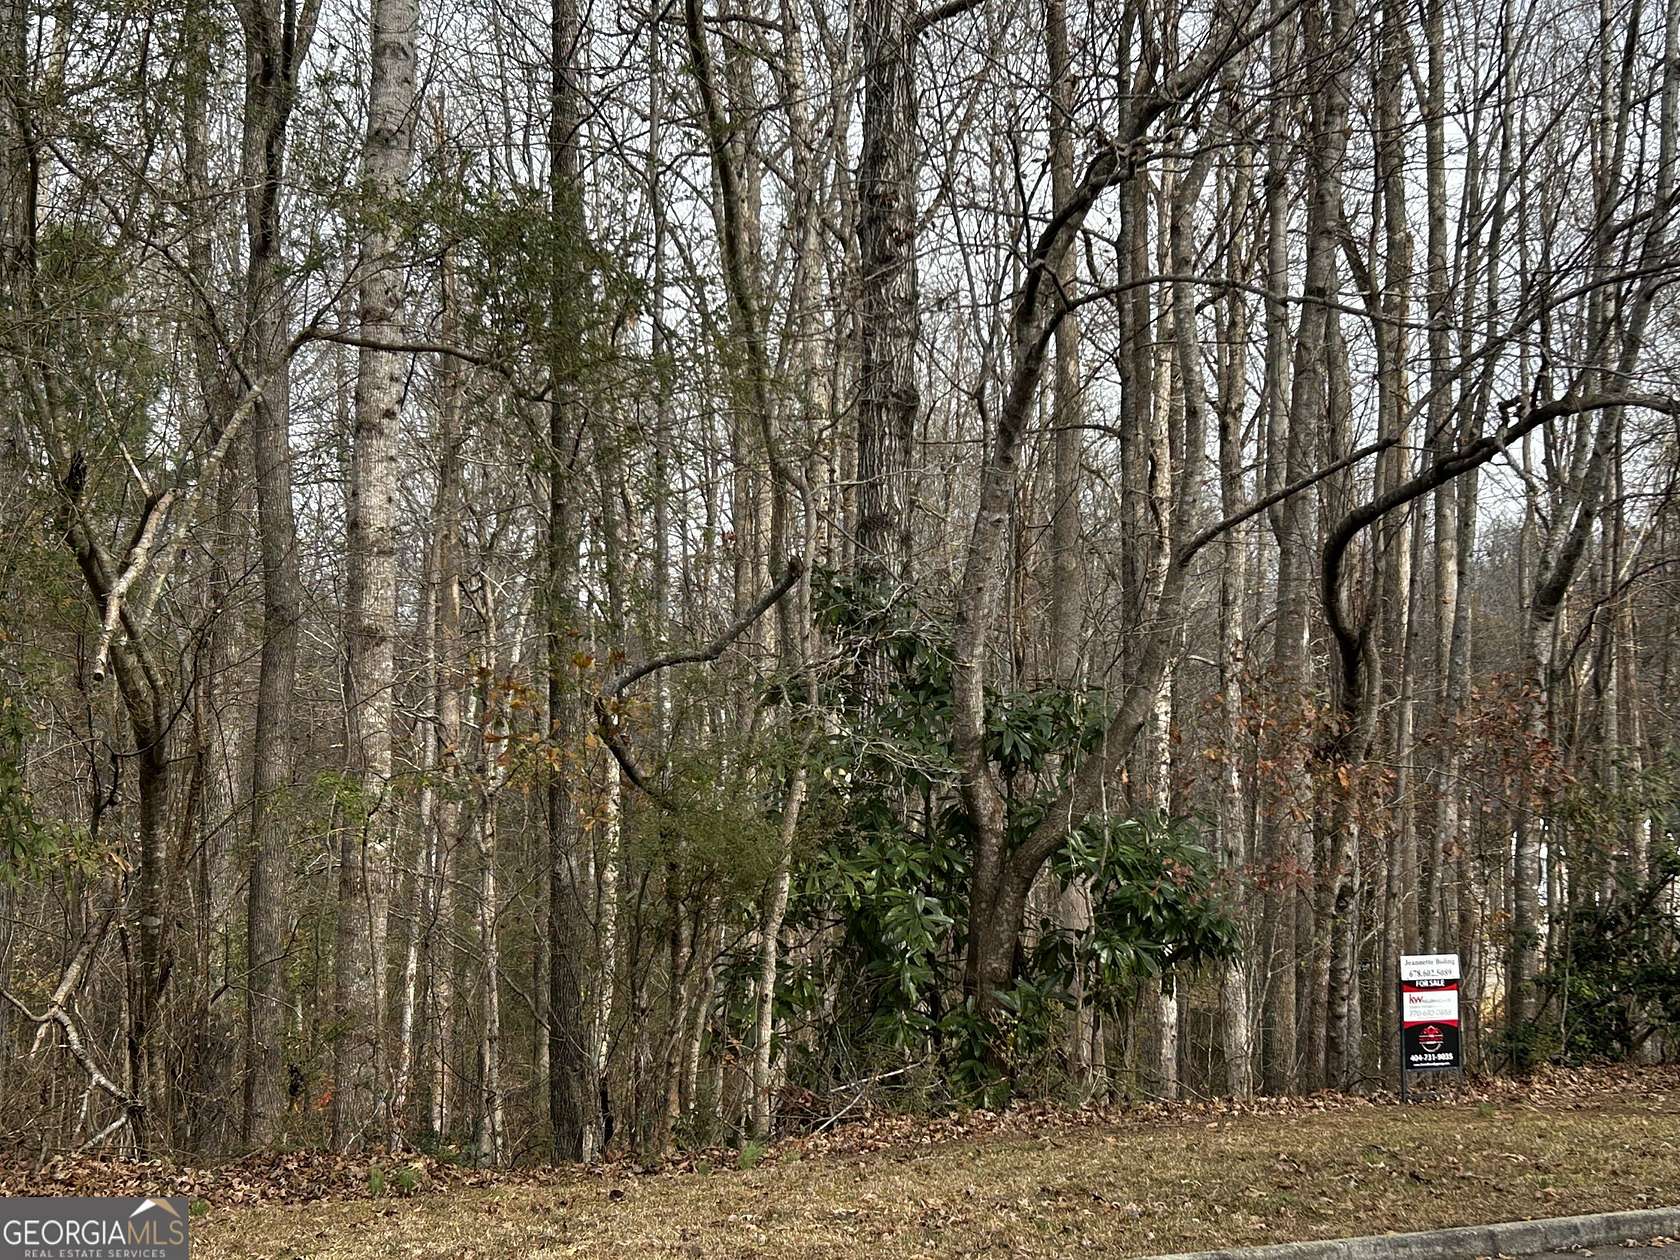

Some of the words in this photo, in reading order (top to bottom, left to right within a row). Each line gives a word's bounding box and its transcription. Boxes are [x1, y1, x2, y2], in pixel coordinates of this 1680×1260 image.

[1415, 979, 1428, 987] FOR
[1428, 979, 1445, 987] SALE
[1409, 993, 1423, 1004] kw
